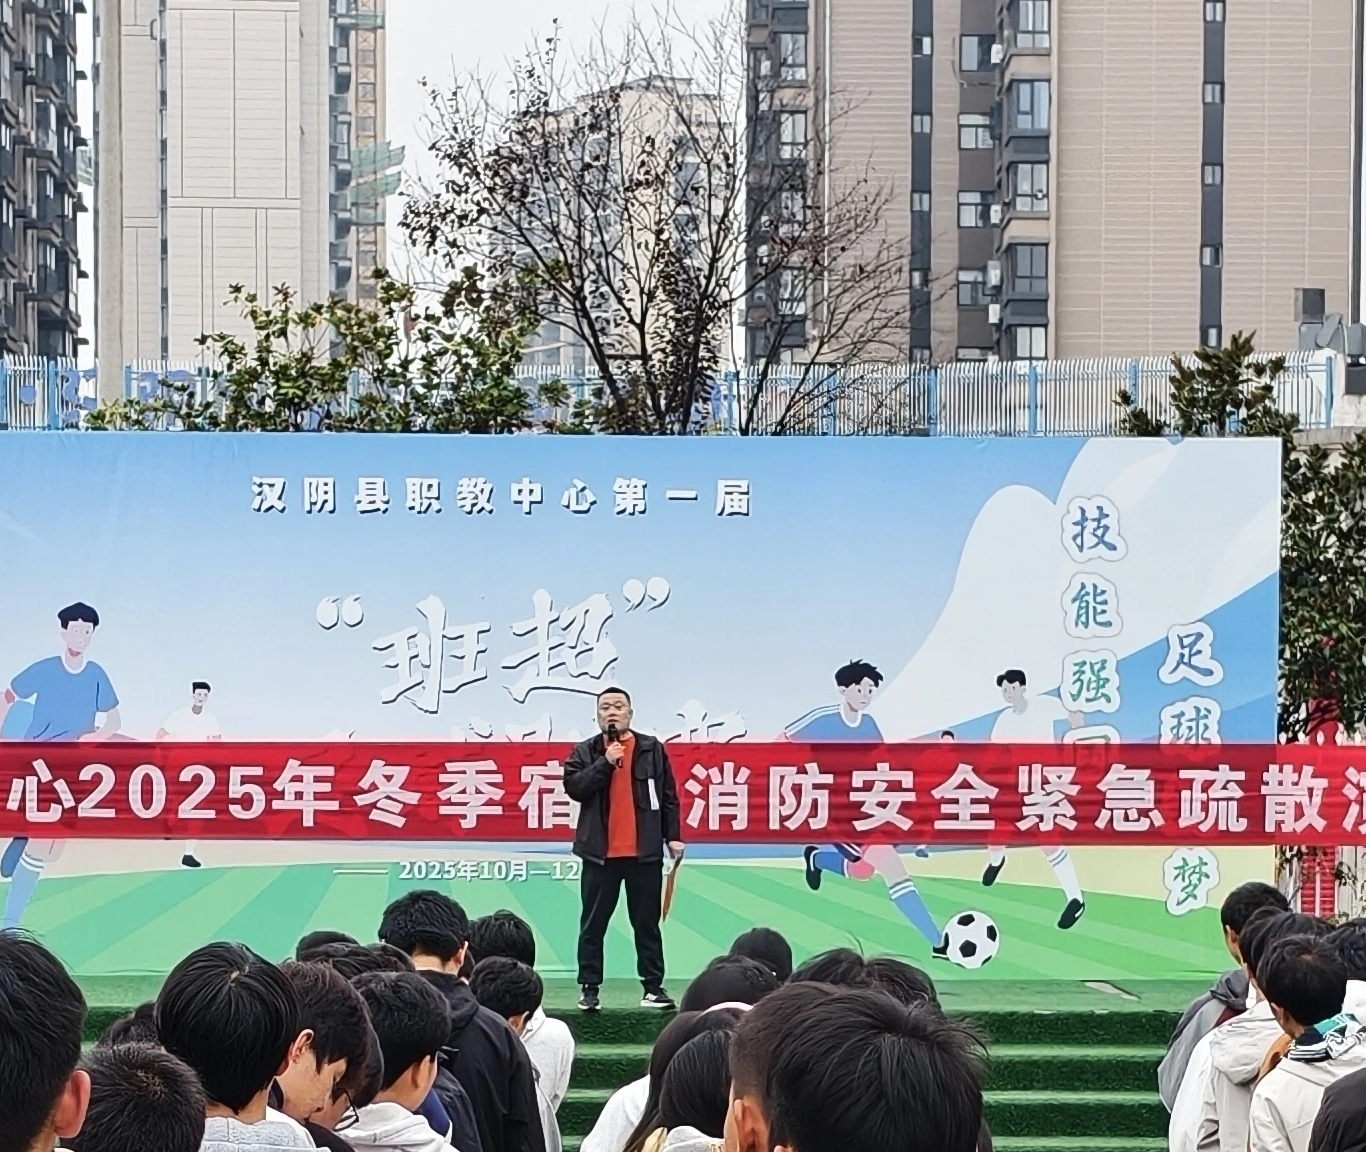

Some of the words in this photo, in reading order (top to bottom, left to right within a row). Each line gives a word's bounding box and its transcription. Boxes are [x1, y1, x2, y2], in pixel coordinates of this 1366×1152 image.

[250, 476, 752, 517] 汉阴县职教中心第一届
[1168, 631, 1215, 907] 足球梦
